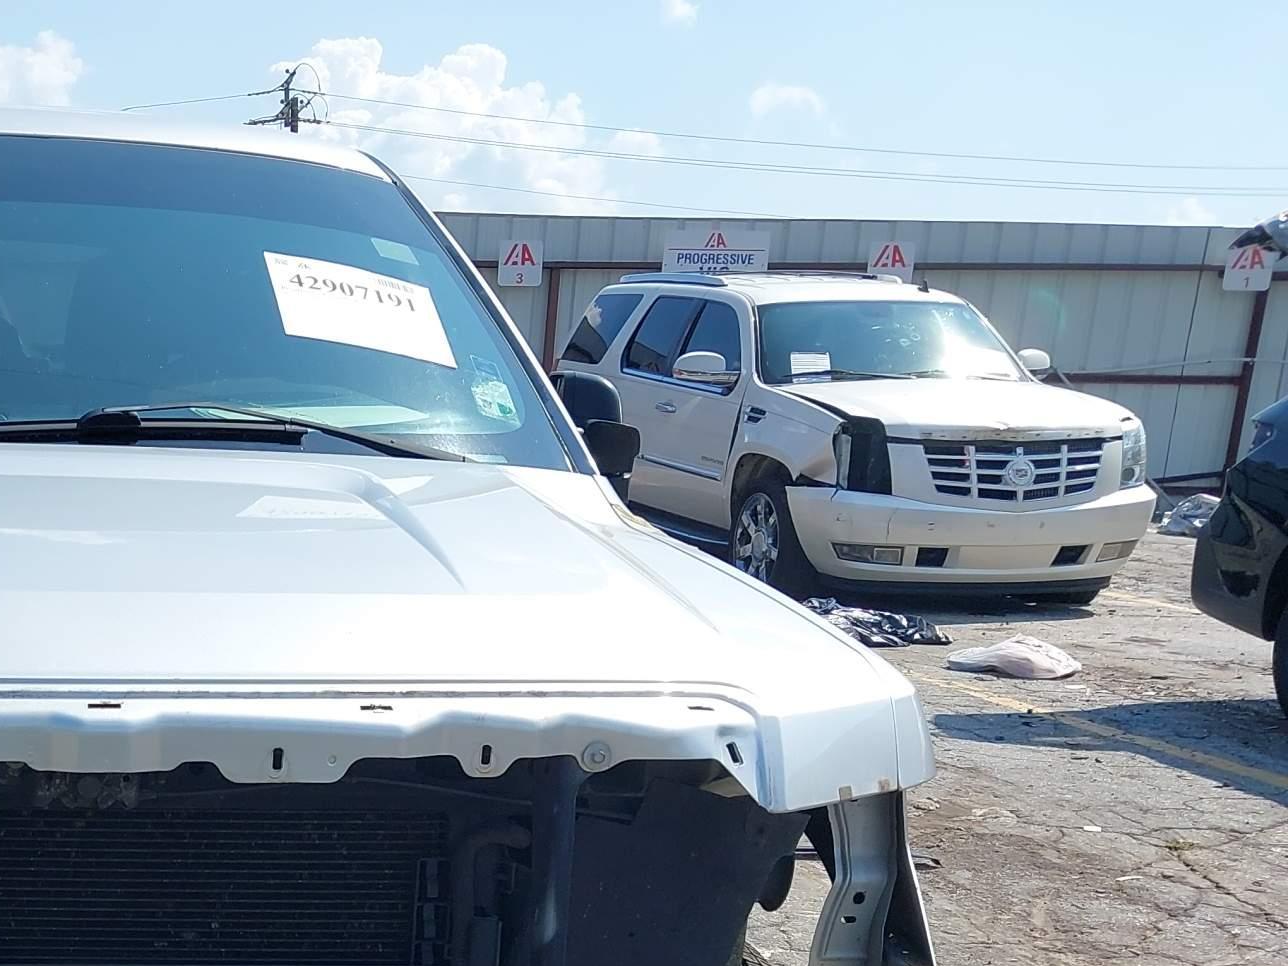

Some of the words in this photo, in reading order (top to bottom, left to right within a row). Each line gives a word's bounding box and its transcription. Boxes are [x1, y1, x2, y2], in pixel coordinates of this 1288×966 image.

[676, 252, 755, 265] PROGRESSIVE
[515, 272, 524, 284] 3
[1243, 276, 1250, 289] 1
[289, 273, 416, 312] 42907191
